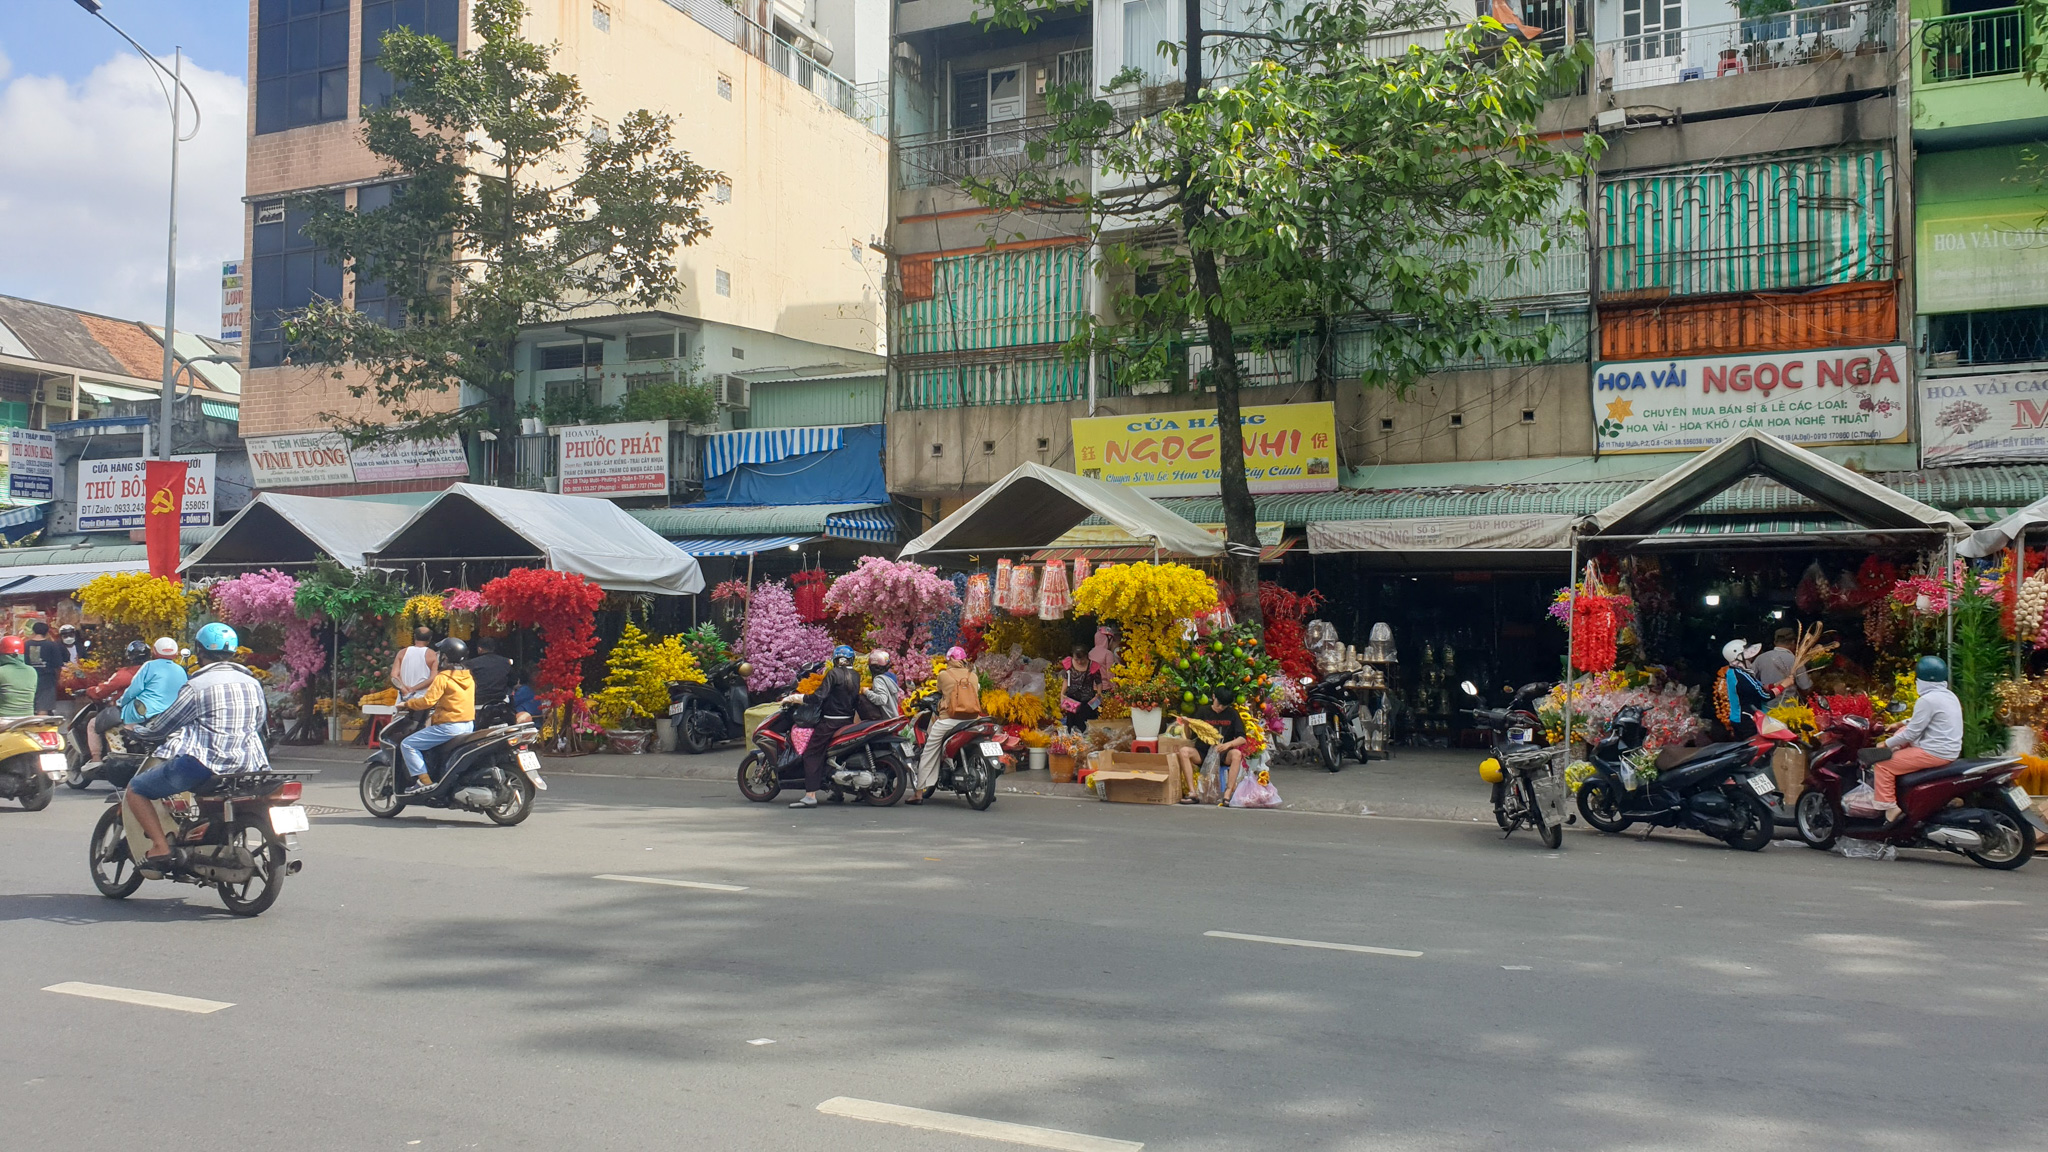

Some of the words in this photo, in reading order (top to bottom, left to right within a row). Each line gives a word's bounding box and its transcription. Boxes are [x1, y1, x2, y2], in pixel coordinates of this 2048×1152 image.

[1934, 233, 1966, 251] HOA
[1598, 371, 1646, 391] HOA
[1651, 362, 1686, 388] VẢI
[1703, 361, 1803, 398] NGỌC
[1817, 348, 1900, 388] NGÀ
[1927, 384, 1967, 400] HOA
[1974, 378, 2007, 395] VẢI
[1643, 407, 1686, 418] CHUYÊN
[1692, 406, 1715, 415] MUA
[1719, 404, 1742, 414] BÁN
[1760, 404, 1768, 412] &
[1789, 400, 1812, 411] CÁC
[565, 430, 583, 438] HOA
[585, 427, 599, 436] VẢI
[1127, 418, 1180, 432] CỬA
[1627, 424, 1648, 433] HOA
[1653, 420, 1668, 432] VẢI
[1680, 422, 1702, 431] HOA
[1706, 419, 1729, 429] KHÔ
[1768, 417, 1791, 427] HOA
[1795, 414, 1826, 426] NGHỆ
[1832, 412, 1870, 425] THUẬT
[271, 438, 292, 450] TIỆM
[565, 435, 616, 459] PHƯỚC
[621, 432, 663, 455] PHÁT
[1105, 434, 1215, 466] NGỌC
[92, 462, 108, 473] CỬA
[111, 460, 132, 472] HÀNG
[253, 450, 293, 471] VĨNH
[1172, 470, 1197, 480] Hoa
[85, 476, 116, 499] THÚ
